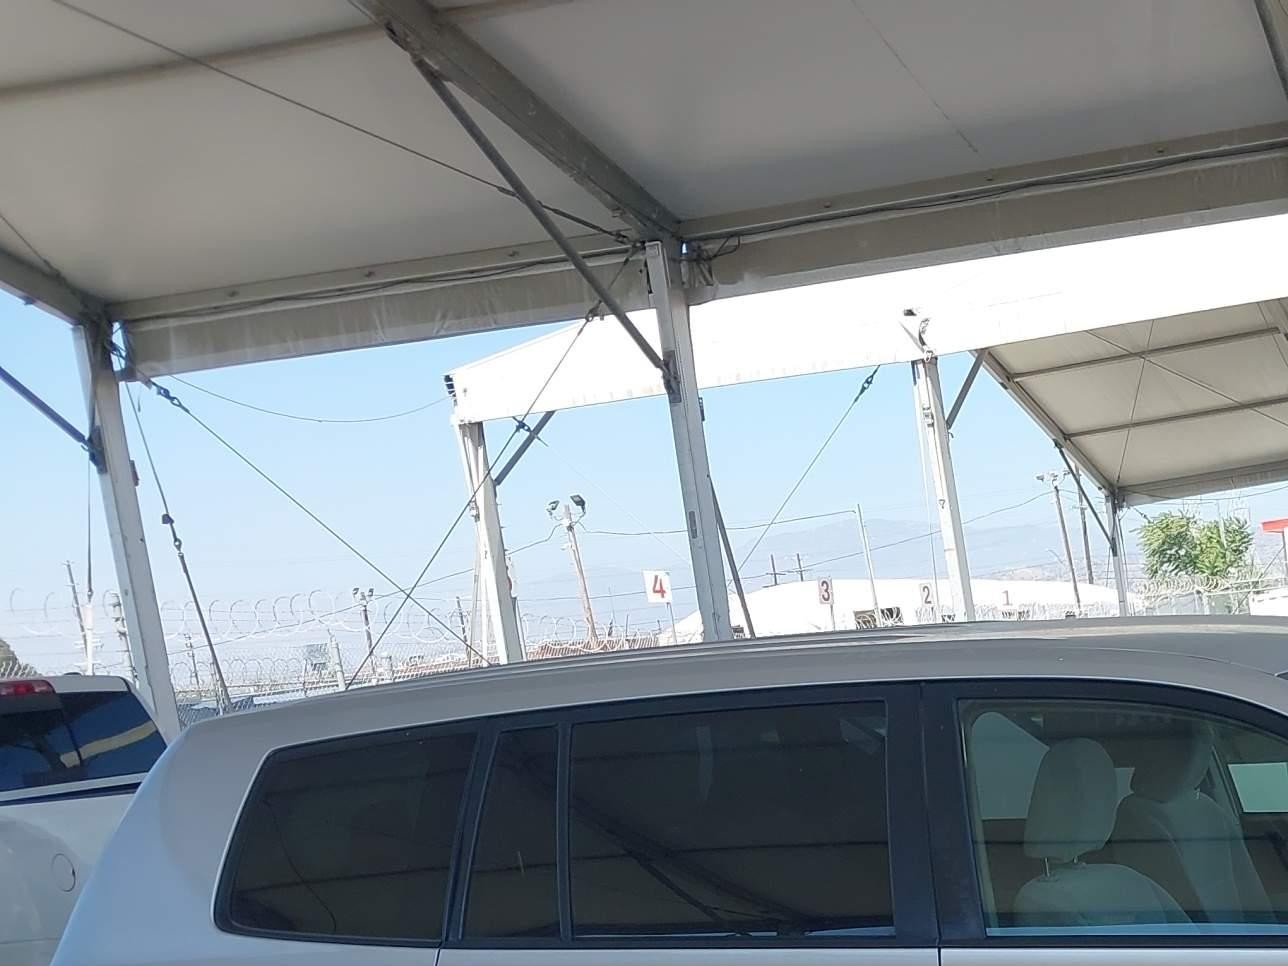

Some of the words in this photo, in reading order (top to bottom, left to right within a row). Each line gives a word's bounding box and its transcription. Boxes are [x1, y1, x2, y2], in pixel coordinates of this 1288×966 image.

[652, 574, 666, 599] 4
[820, 580, 831, 602] 3
[922, 585, 932, 604] 2
